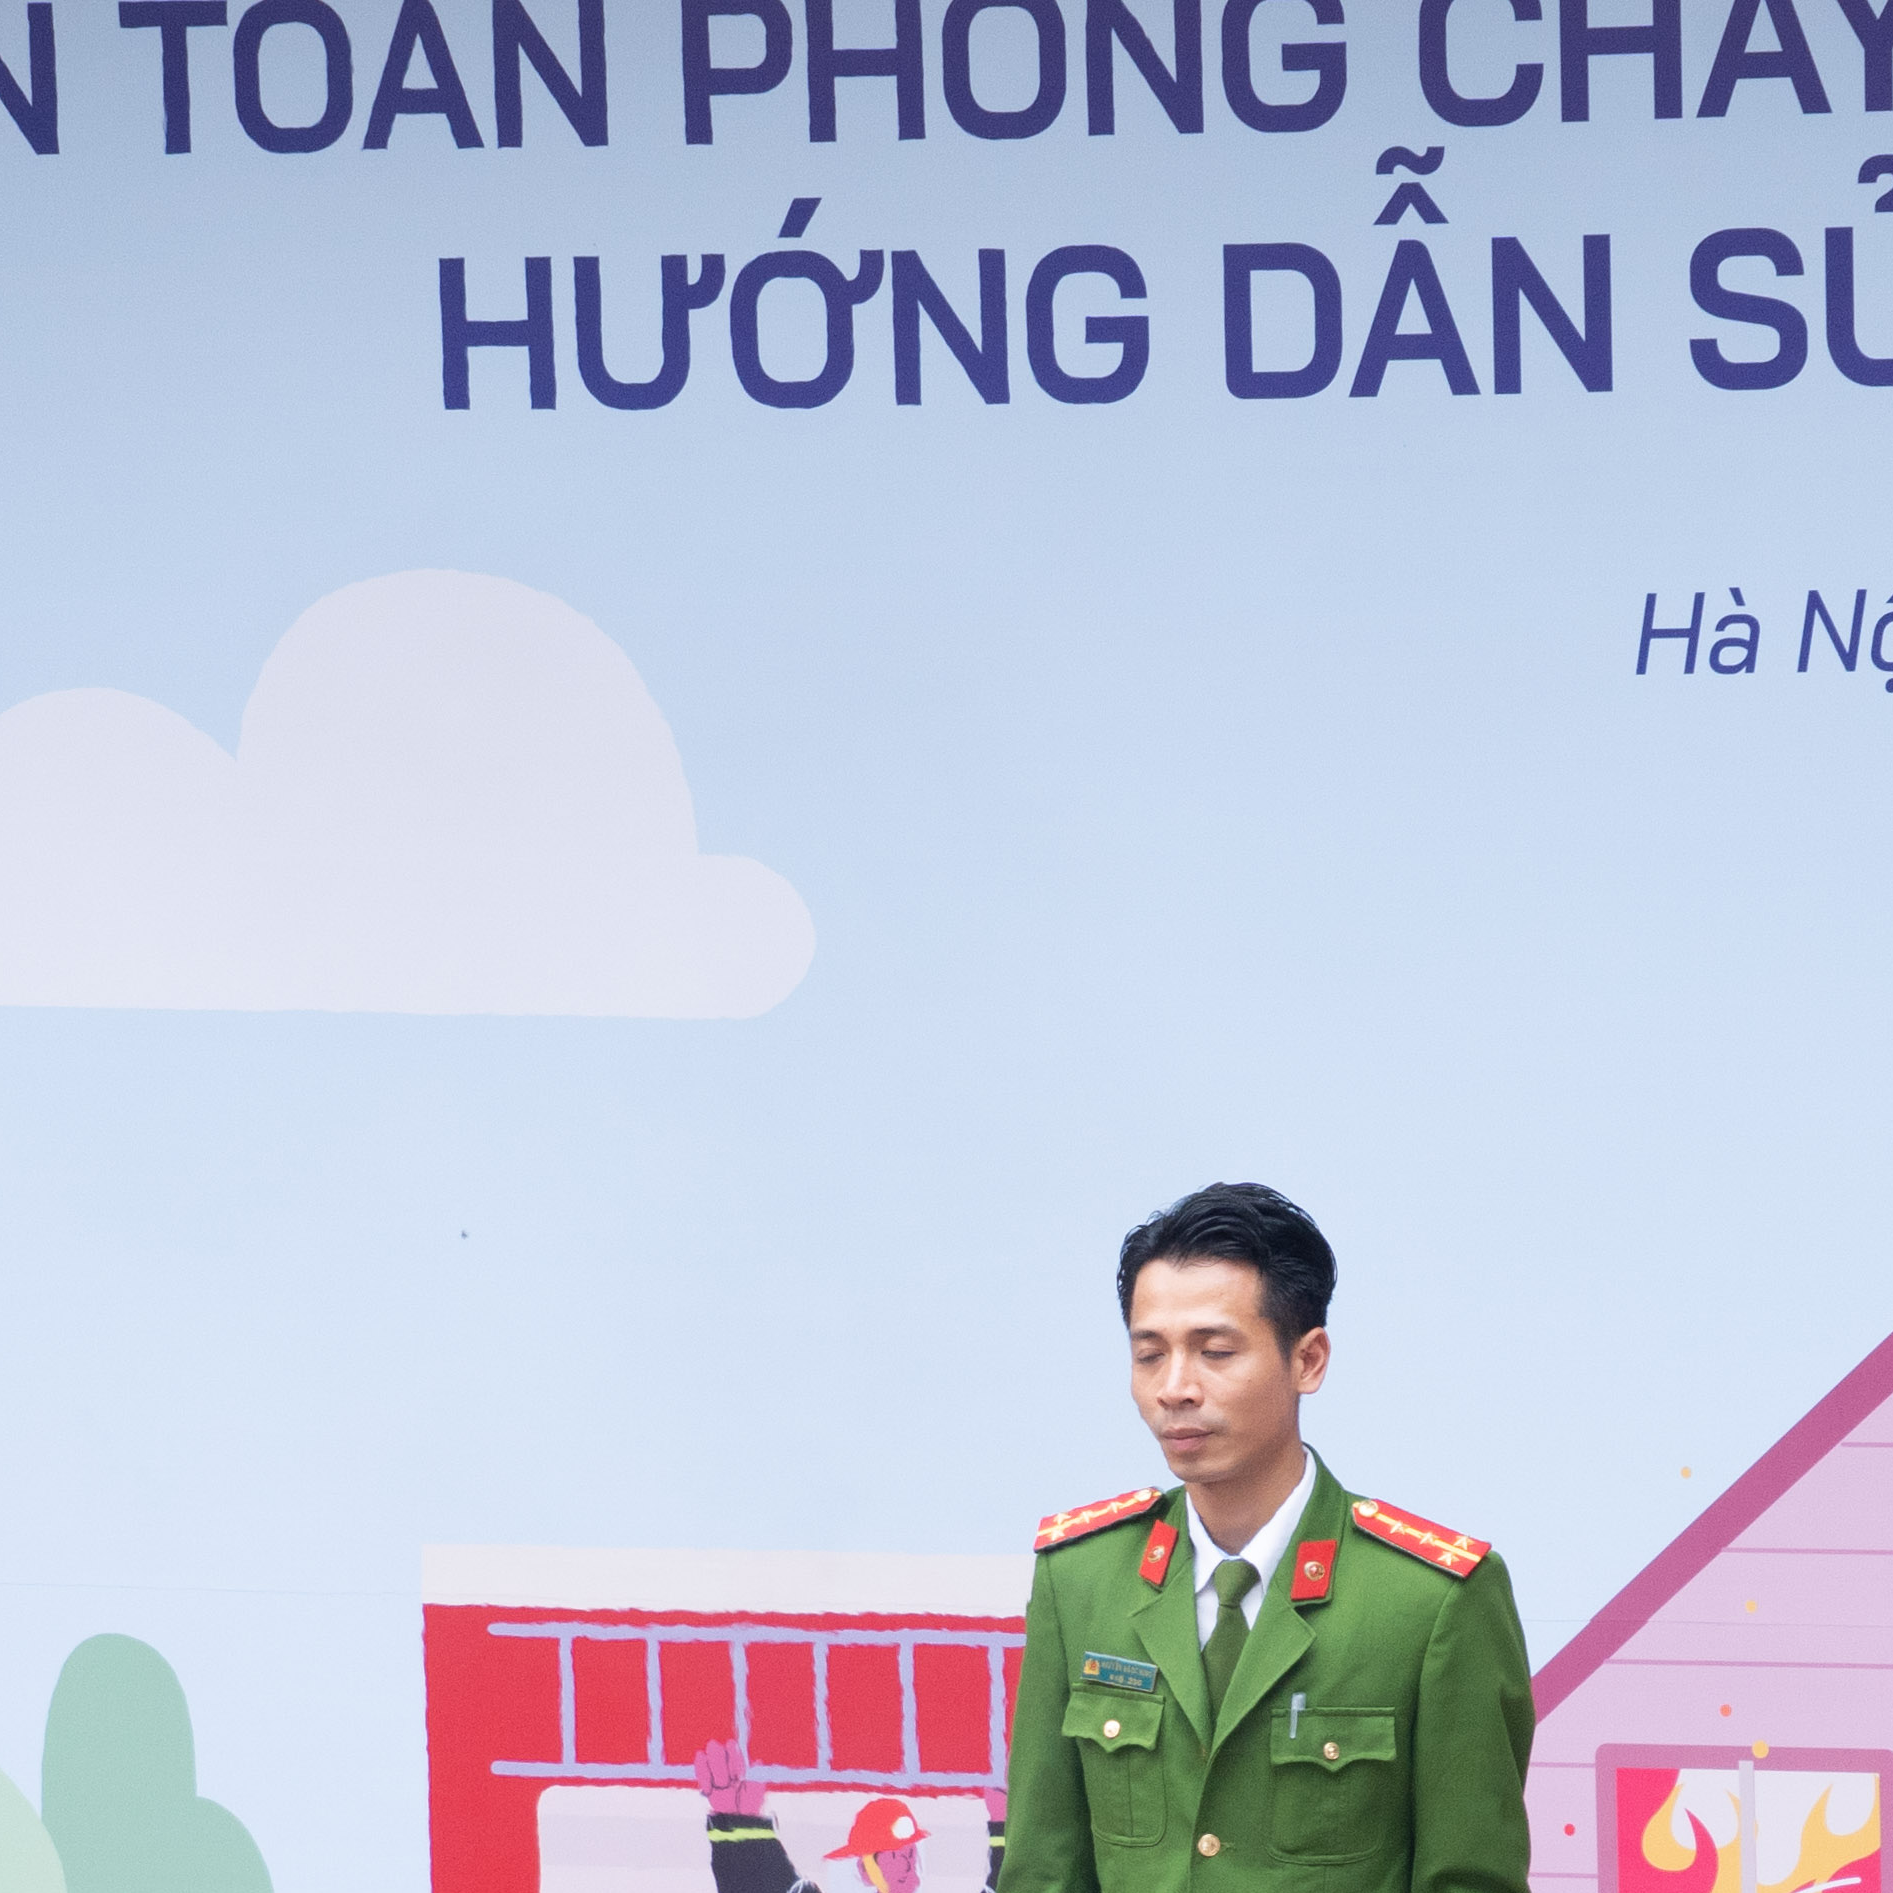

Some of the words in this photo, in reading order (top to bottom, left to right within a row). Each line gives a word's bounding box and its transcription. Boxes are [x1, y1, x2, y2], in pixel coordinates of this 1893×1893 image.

[439, 198, 1149, 410] HƯỚNG
[1223, 146, 1612, 399] DẪN
[1637, 588, 1759, 674] Hà
